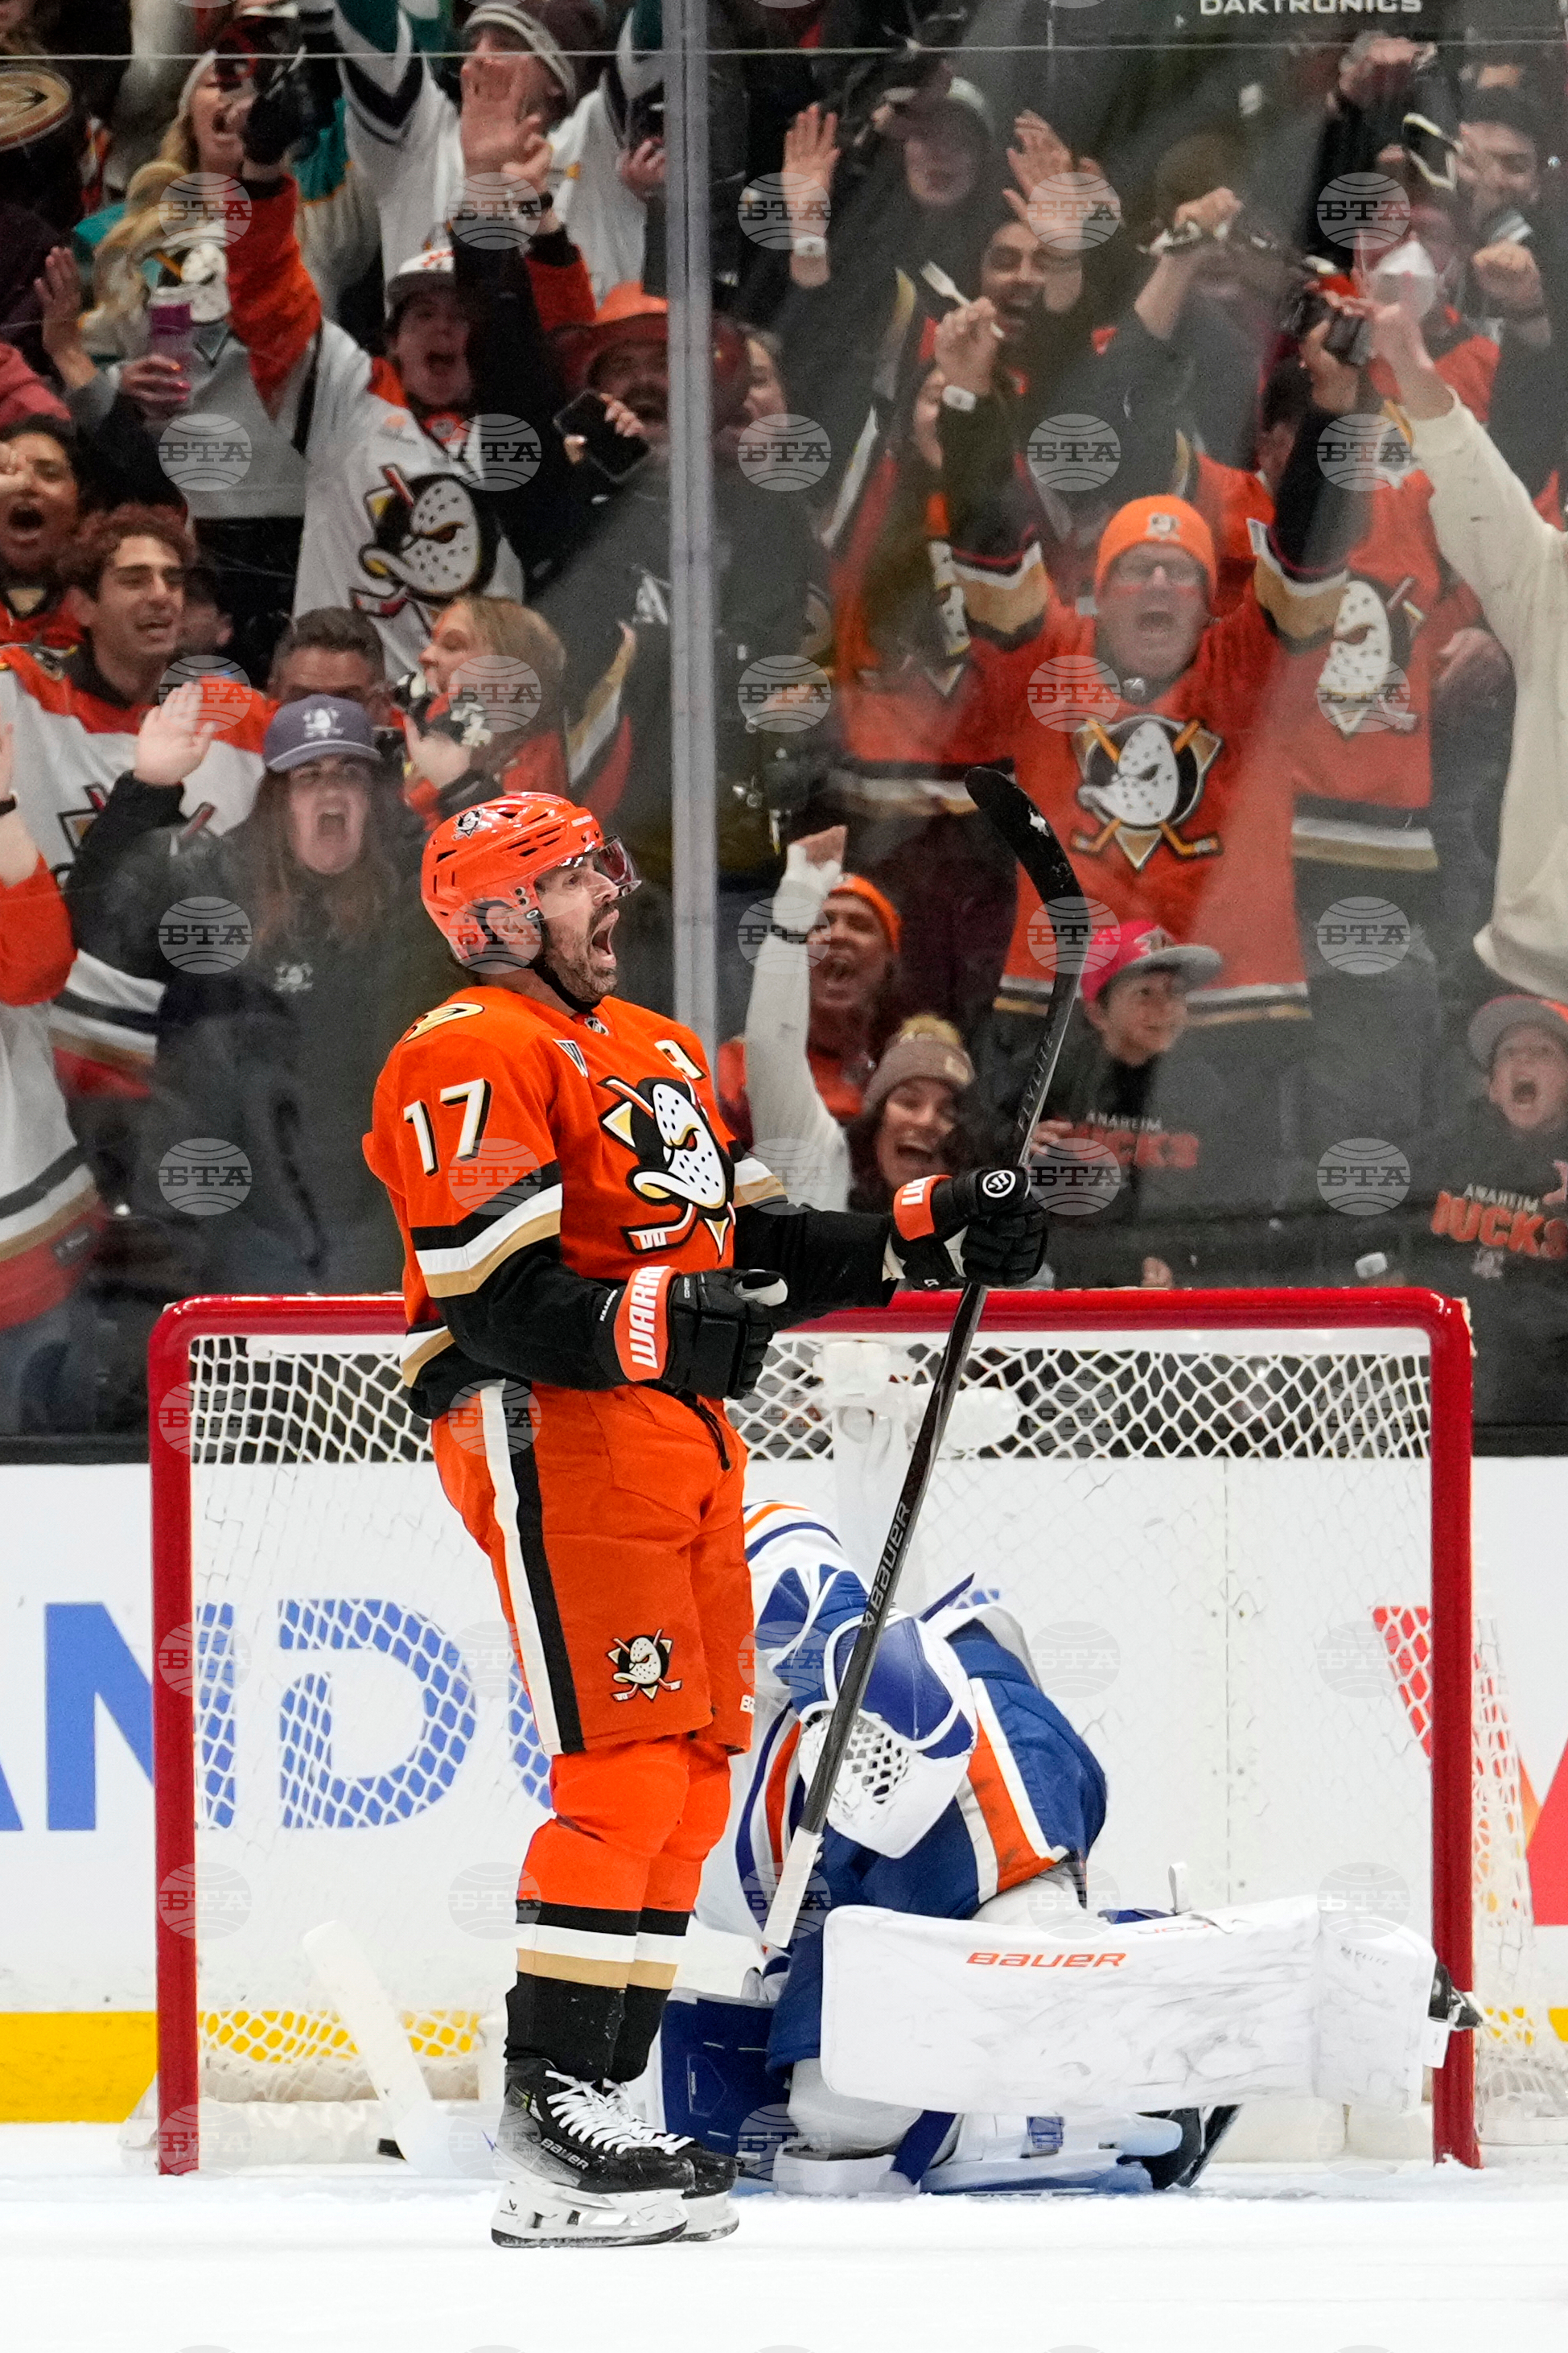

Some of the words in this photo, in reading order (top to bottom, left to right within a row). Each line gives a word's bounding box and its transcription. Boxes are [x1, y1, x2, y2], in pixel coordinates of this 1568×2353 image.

[403, 1078, 492, 1176] 17
[629, 1265, 671, 1369] WARR
[870, 1500, 911, 1613] BAUER
[966, 1951, 1126, 1968] BAUER
[540, 2137, 589, 2170] BAUER
